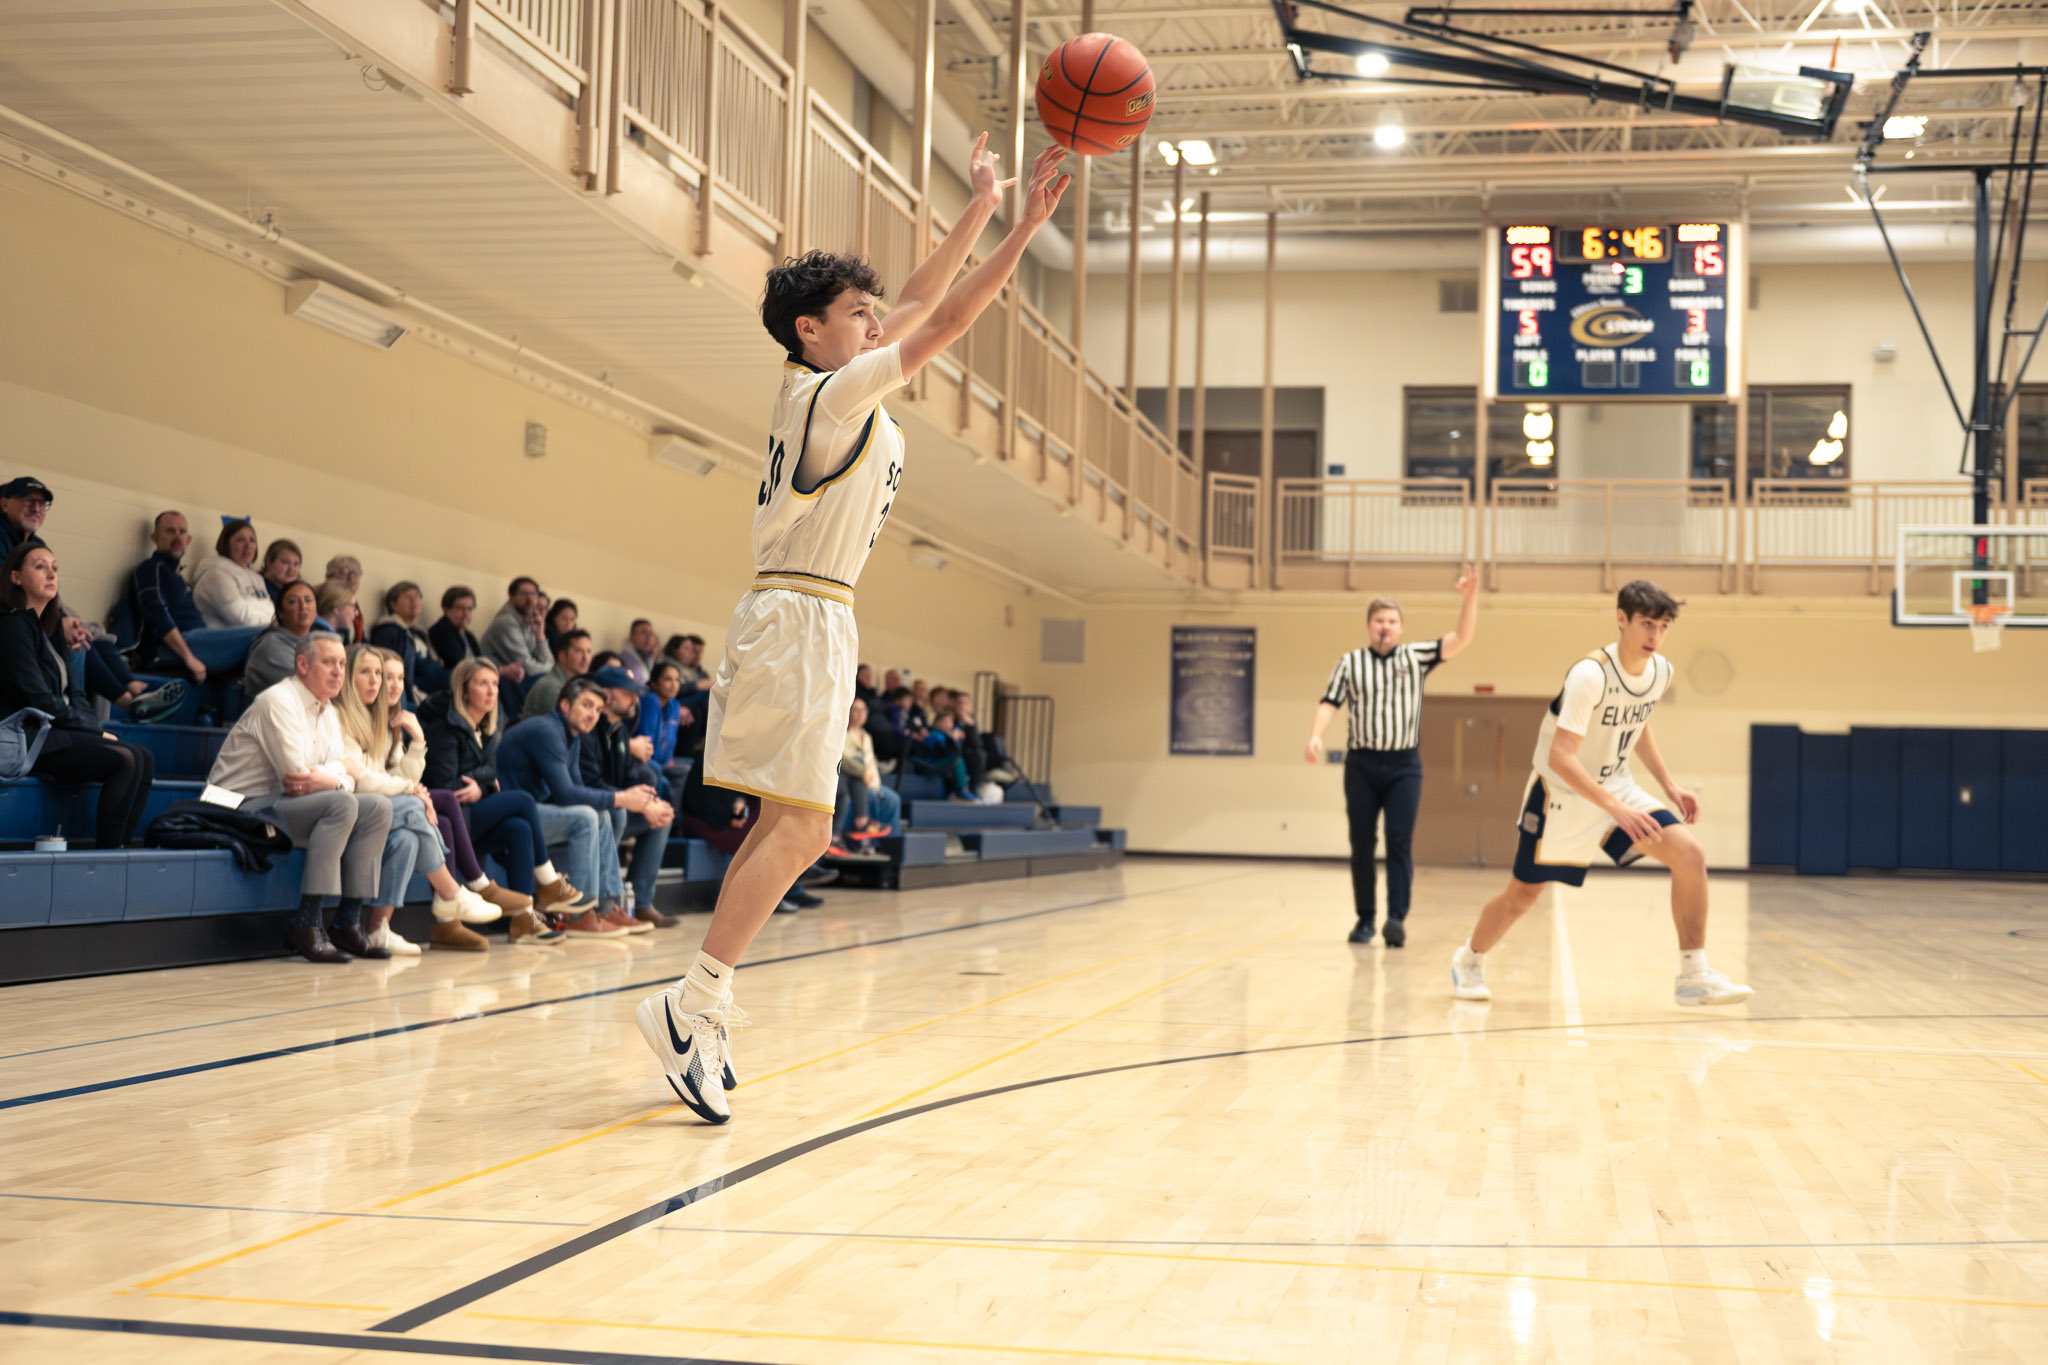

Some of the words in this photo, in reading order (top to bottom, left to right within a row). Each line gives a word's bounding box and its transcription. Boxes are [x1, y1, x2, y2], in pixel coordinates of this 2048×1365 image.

[1582, 227, 1663, 259] 6:46
[1511, 245, 1553, 278] 59
[1694, 243, 1724, 275] 15
[1624, 266, 1643, 294] 3
[1518, 309, 1539, 335] 5
[1606, 319, 1655, 333] STORM
[1687, 308, 1707, 334] 3
[1575, 348, 1616, 362] PLAYER
[1528, 360, 1548, 387] 0
[1690, 360, 1710, 386] 0
[1601, 700, 1657, 727] ELKHOR
